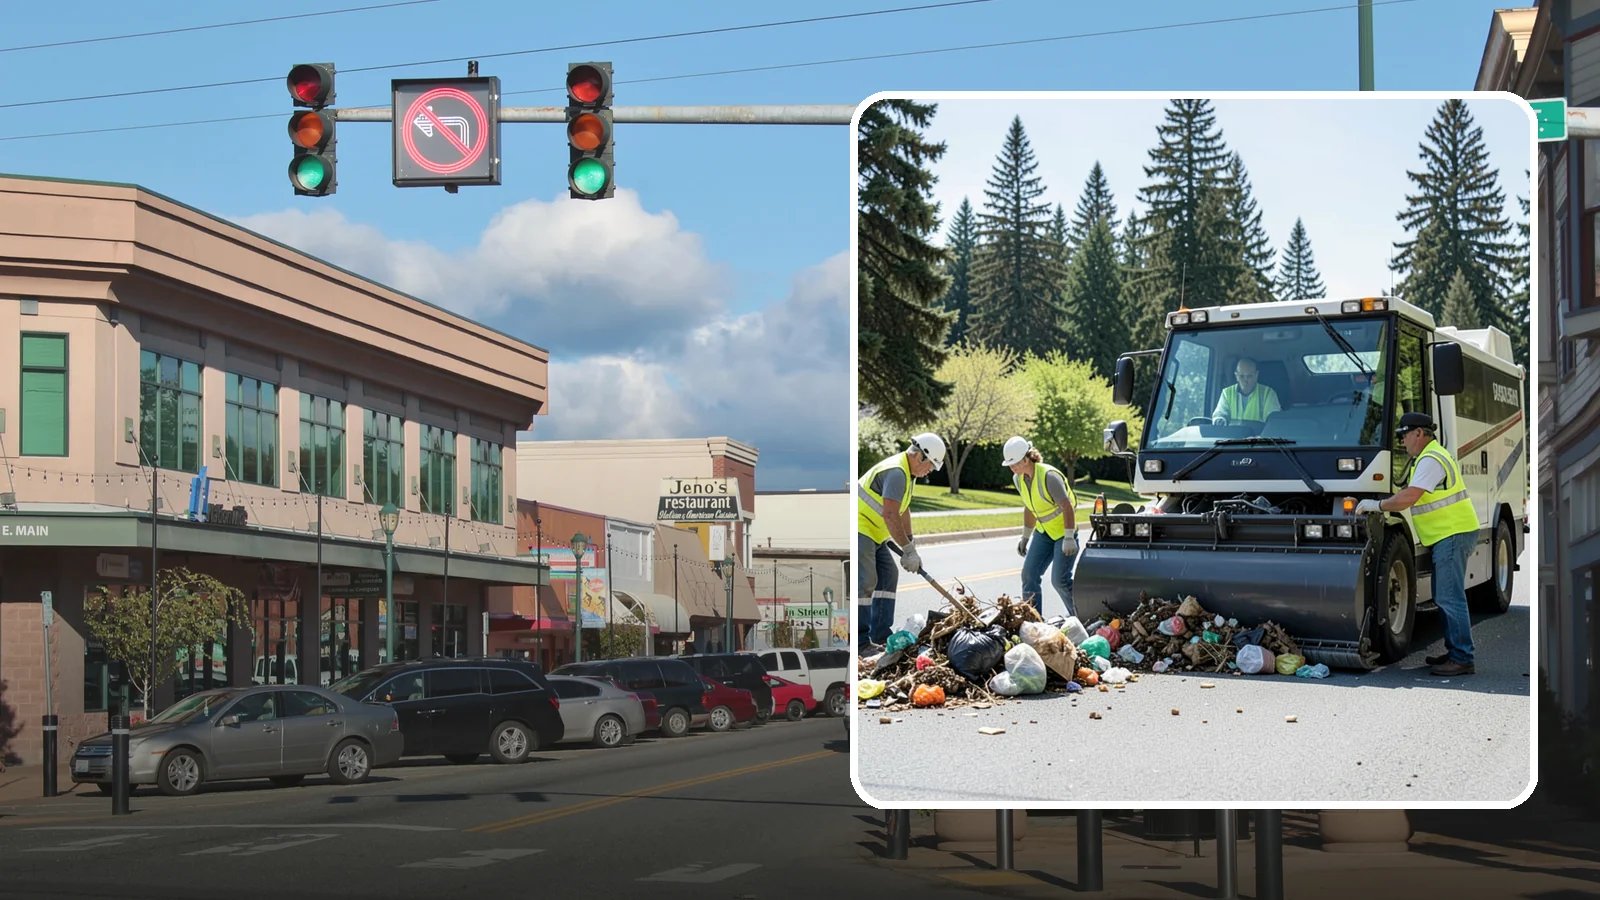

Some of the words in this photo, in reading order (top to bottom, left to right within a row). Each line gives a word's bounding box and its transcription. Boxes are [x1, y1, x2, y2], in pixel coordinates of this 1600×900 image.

[669, 480, 727, 494] Jeno's
[665, 497, 731, 509] restaurant
[659, 510, 681, 519] Italian
[686, 510, 714, 519] American
[715, 509, 737, 519] Cuisine
[2, 525, 13, 536] E.
[15, 525, 49, 536] MAIN
[797, 607, 828, 616] Street
[791, 619, 824, 627] lass
